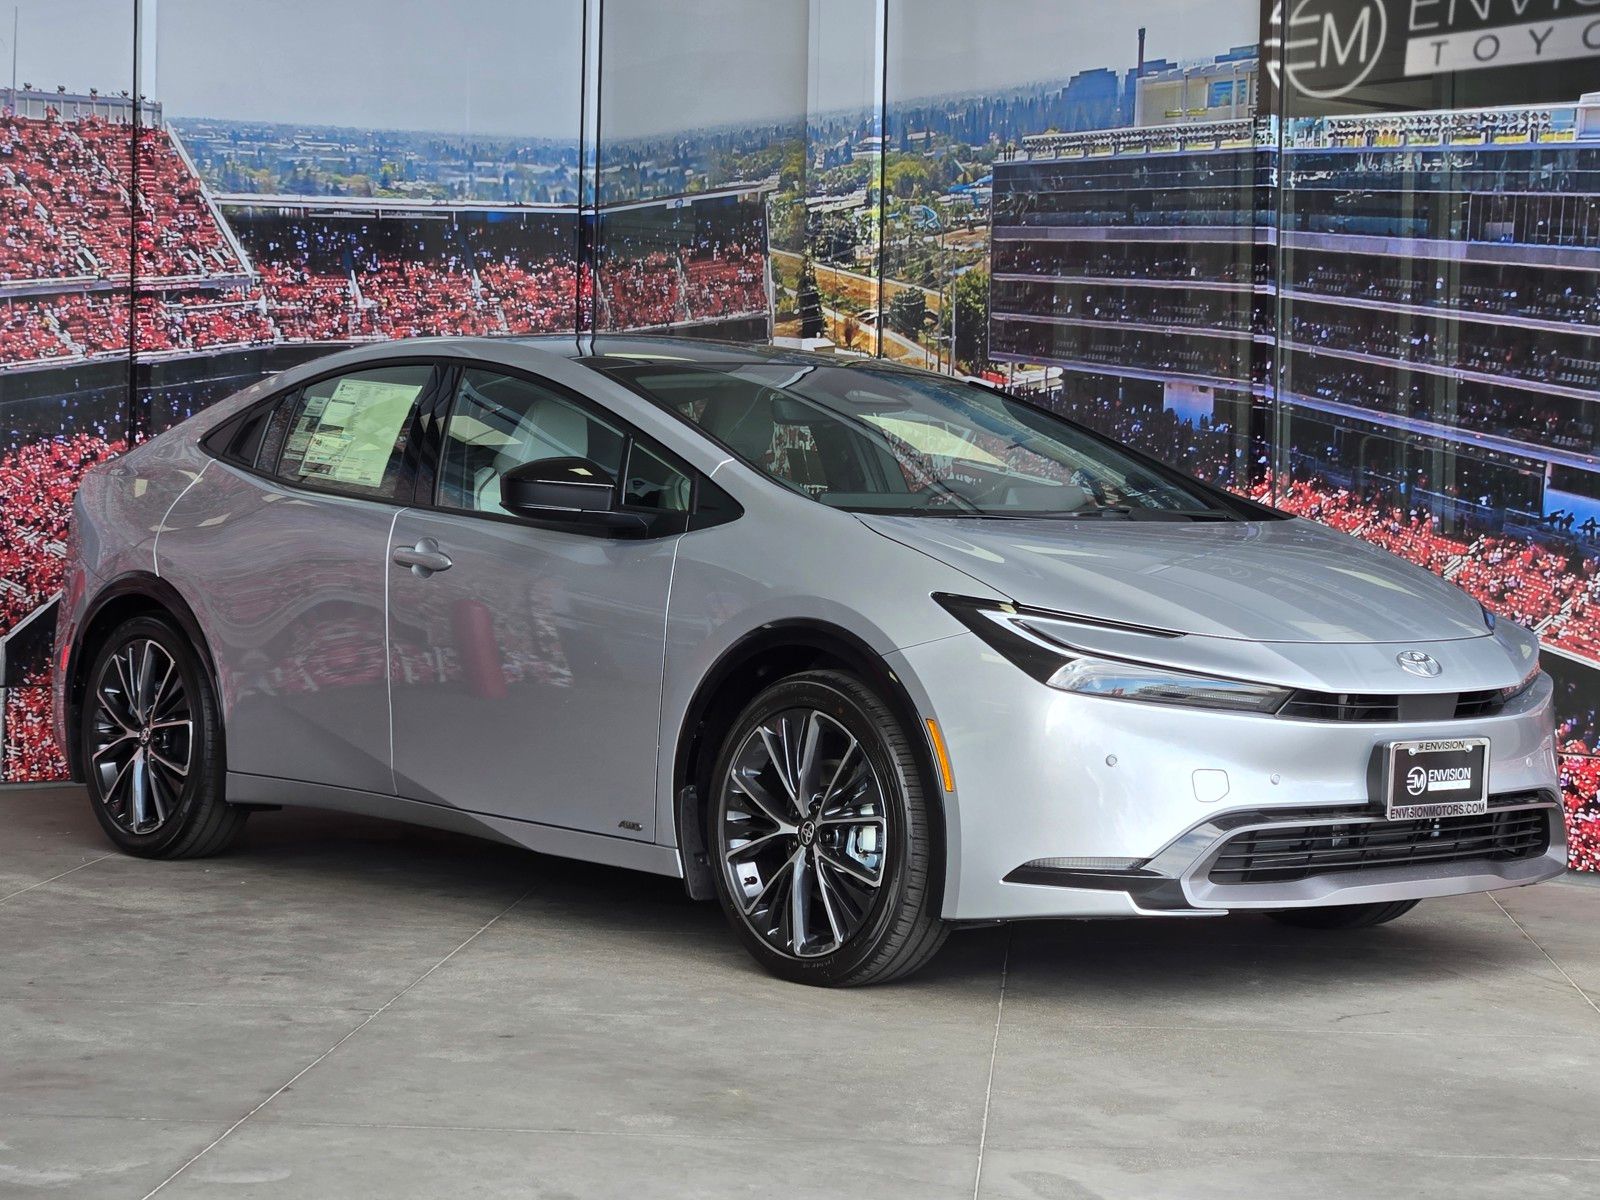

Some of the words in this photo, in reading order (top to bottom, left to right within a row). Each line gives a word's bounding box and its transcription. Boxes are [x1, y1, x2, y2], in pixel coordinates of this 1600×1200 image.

[1425, 741, 1465, 751] ENVISION
[1428, 767, 1471, 782] ENVISION
[1390, 803, 1485, 819] ENVISIONMOTORS.COM
